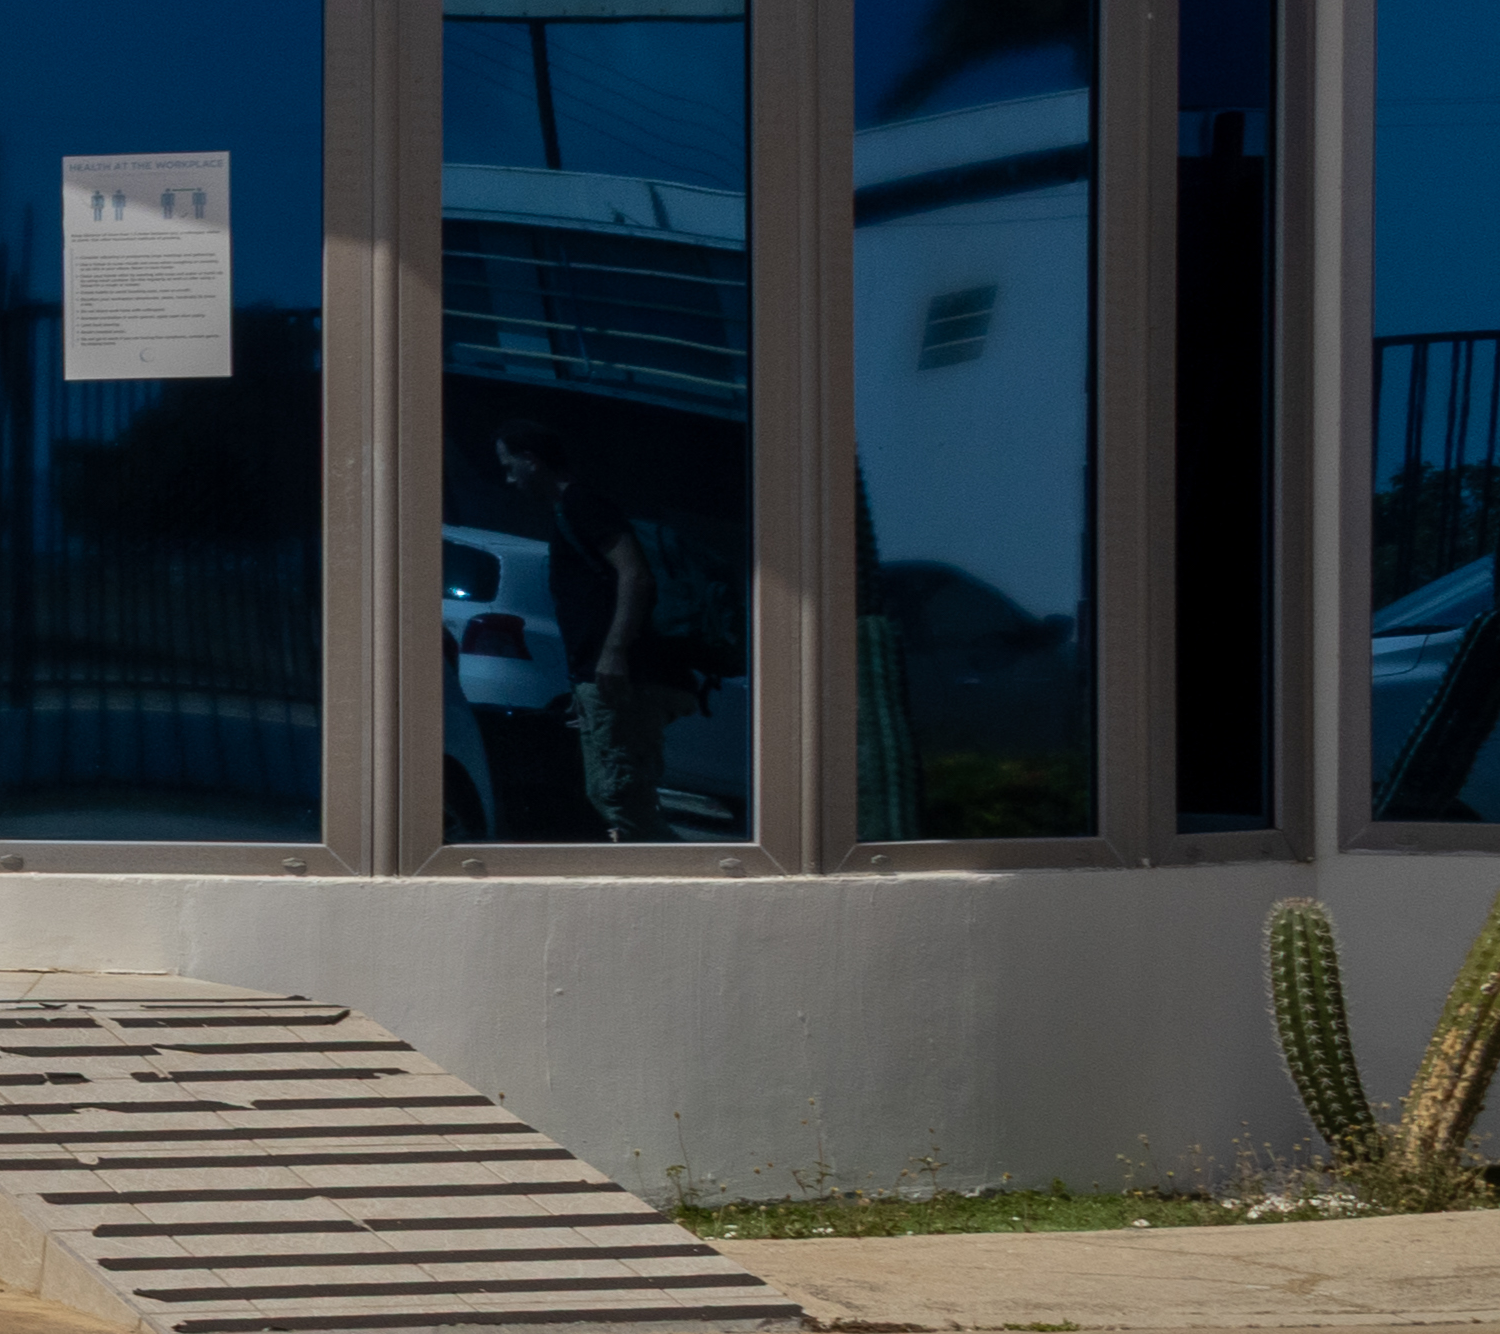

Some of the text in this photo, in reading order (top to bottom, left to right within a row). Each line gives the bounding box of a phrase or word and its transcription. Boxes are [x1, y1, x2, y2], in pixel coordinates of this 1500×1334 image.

[69, 158, 224, 172] HEALTH AT THE WORKPLACE
